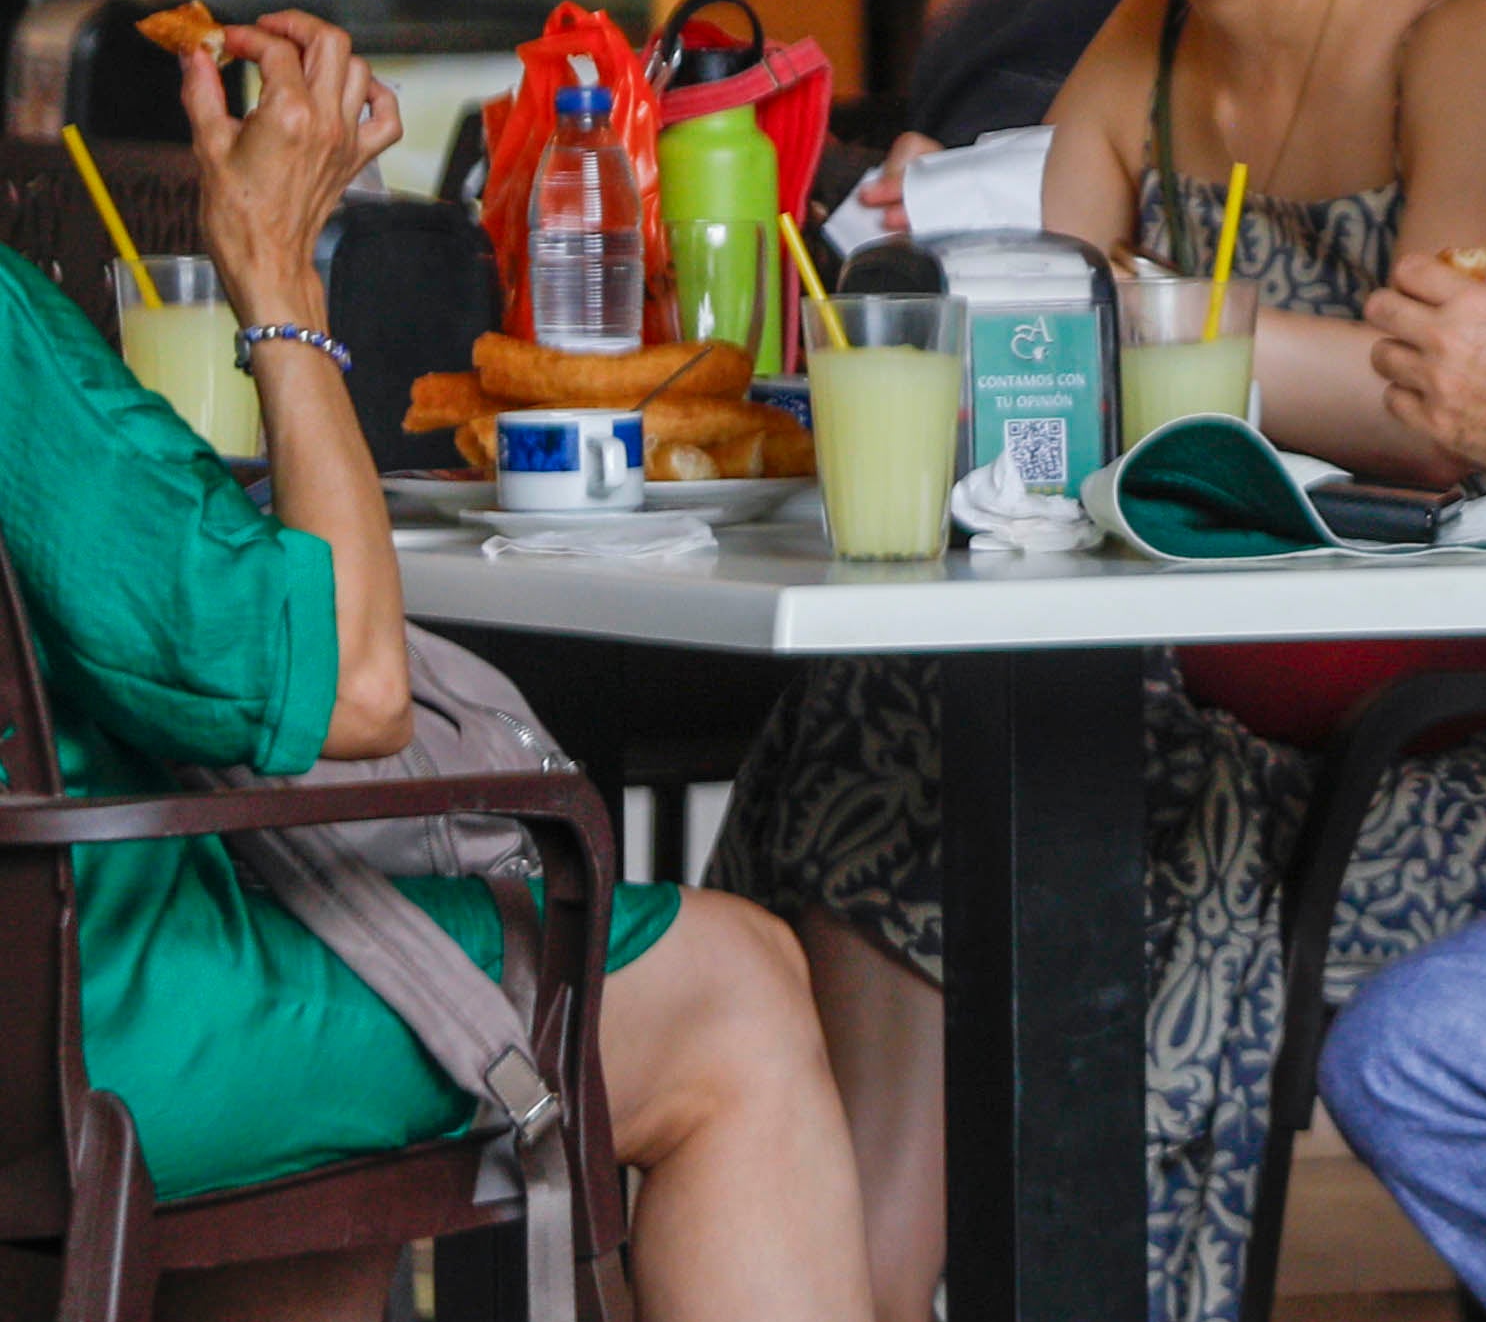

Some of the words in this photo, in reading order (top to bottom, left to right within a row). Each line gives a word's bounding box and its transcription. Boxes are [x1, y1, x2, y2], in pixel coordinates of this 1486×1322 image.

[977, 372, 1054, 390] CONTAMOS
[1057, 372, 1086, 387] CON
[995, 395, 1013, 408] TU
[1016, 390, 1073, 408] OPINIÓN
